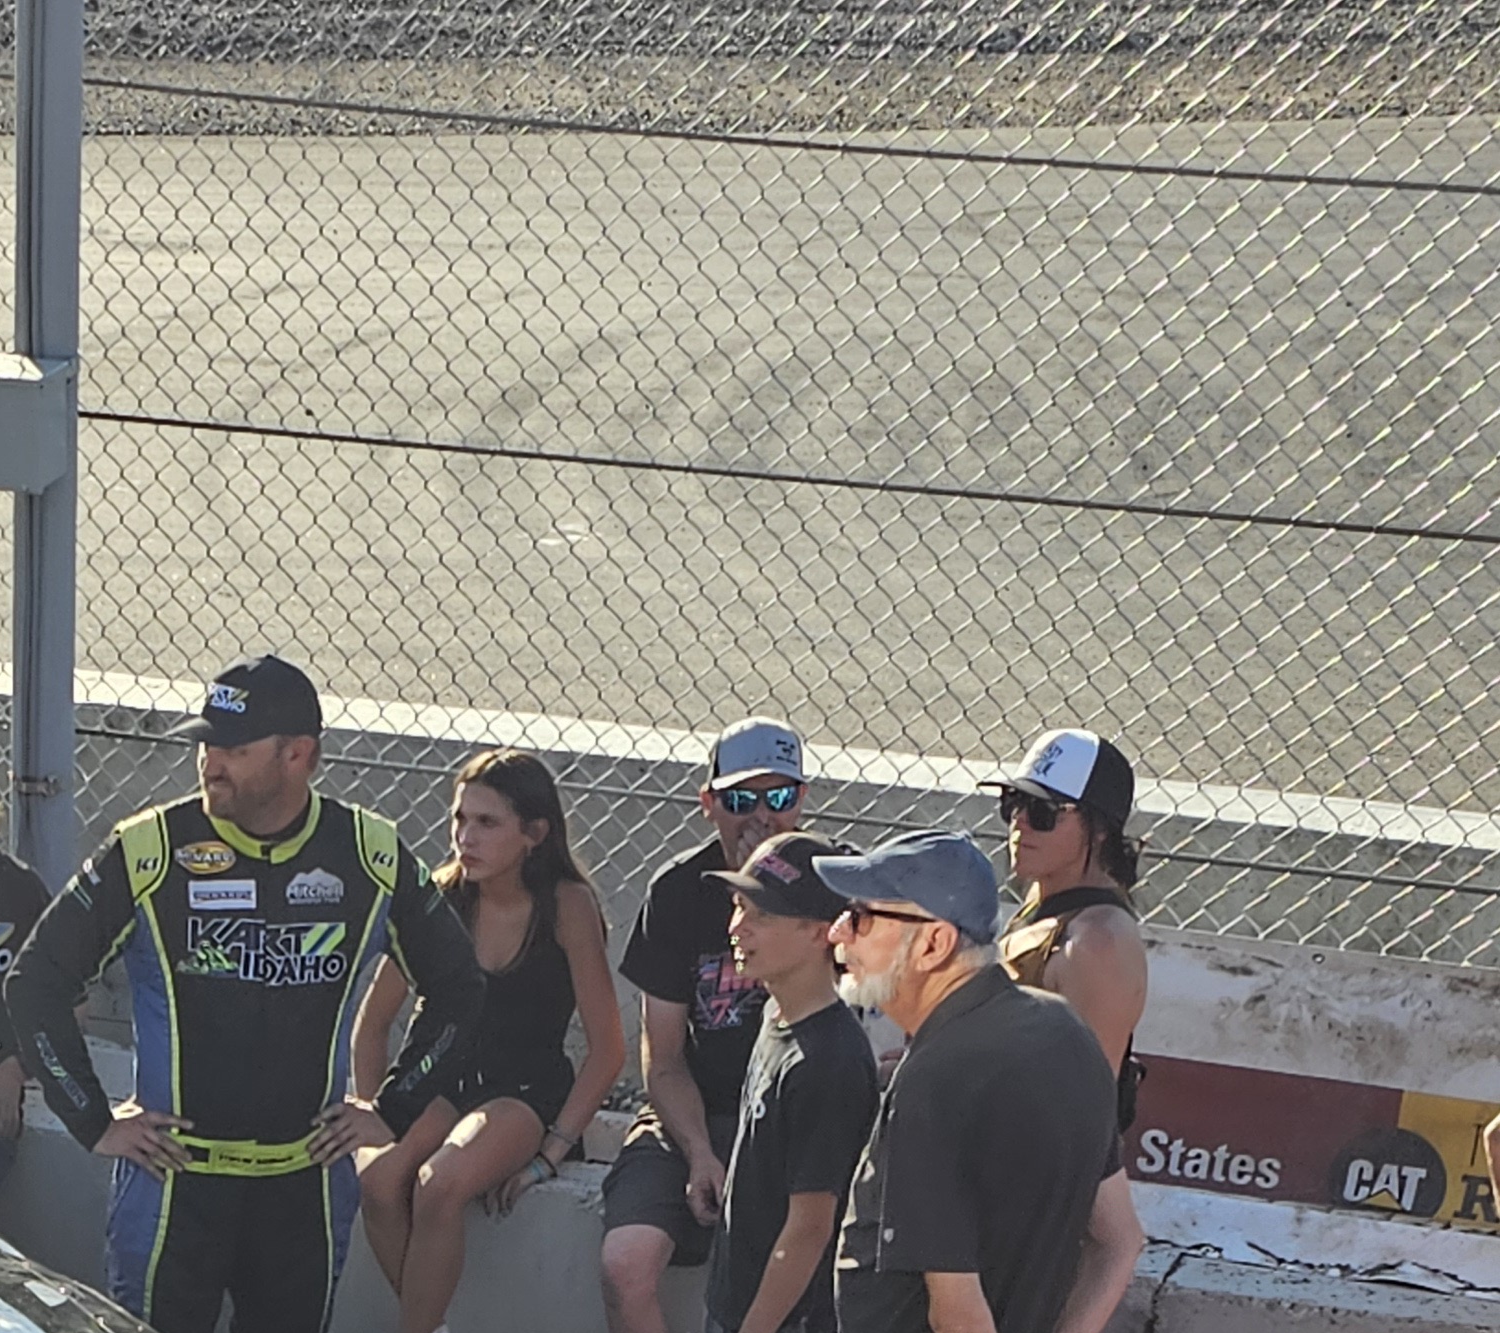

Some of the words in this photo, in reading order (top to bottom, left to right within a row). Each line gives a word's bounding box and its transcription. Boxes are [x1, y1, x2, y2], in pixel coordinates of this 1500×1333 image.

[187, 916, 311, 959] KART
[239, 949, 348, 986] IDAHO
[1136, 1128, 1282, 1189] States
[1342, 1158, 1427, 1212] CAT
